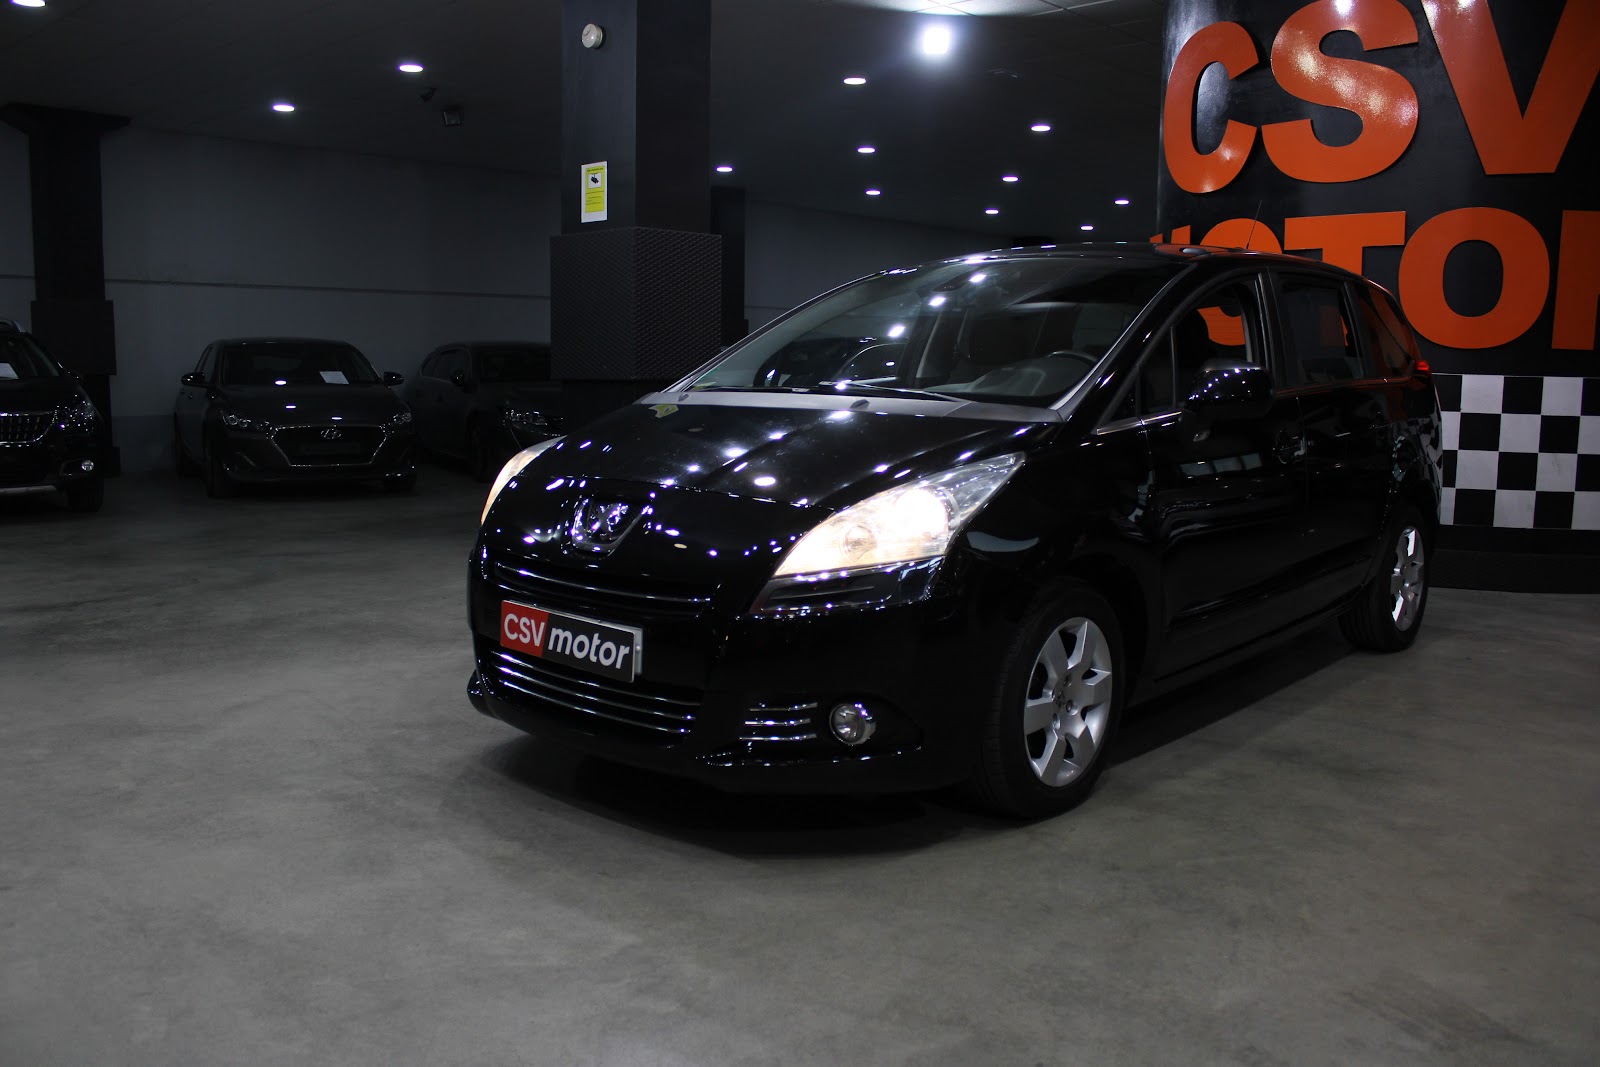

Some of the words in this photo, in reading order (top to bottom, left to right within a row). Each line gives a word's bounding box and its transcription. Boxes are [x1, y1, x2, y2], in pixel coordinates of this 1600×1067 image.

[1163, 0, 1600, 193] CSV
[504, 613, 546, 648] CSV
[548, 627, 630, 670] motor
